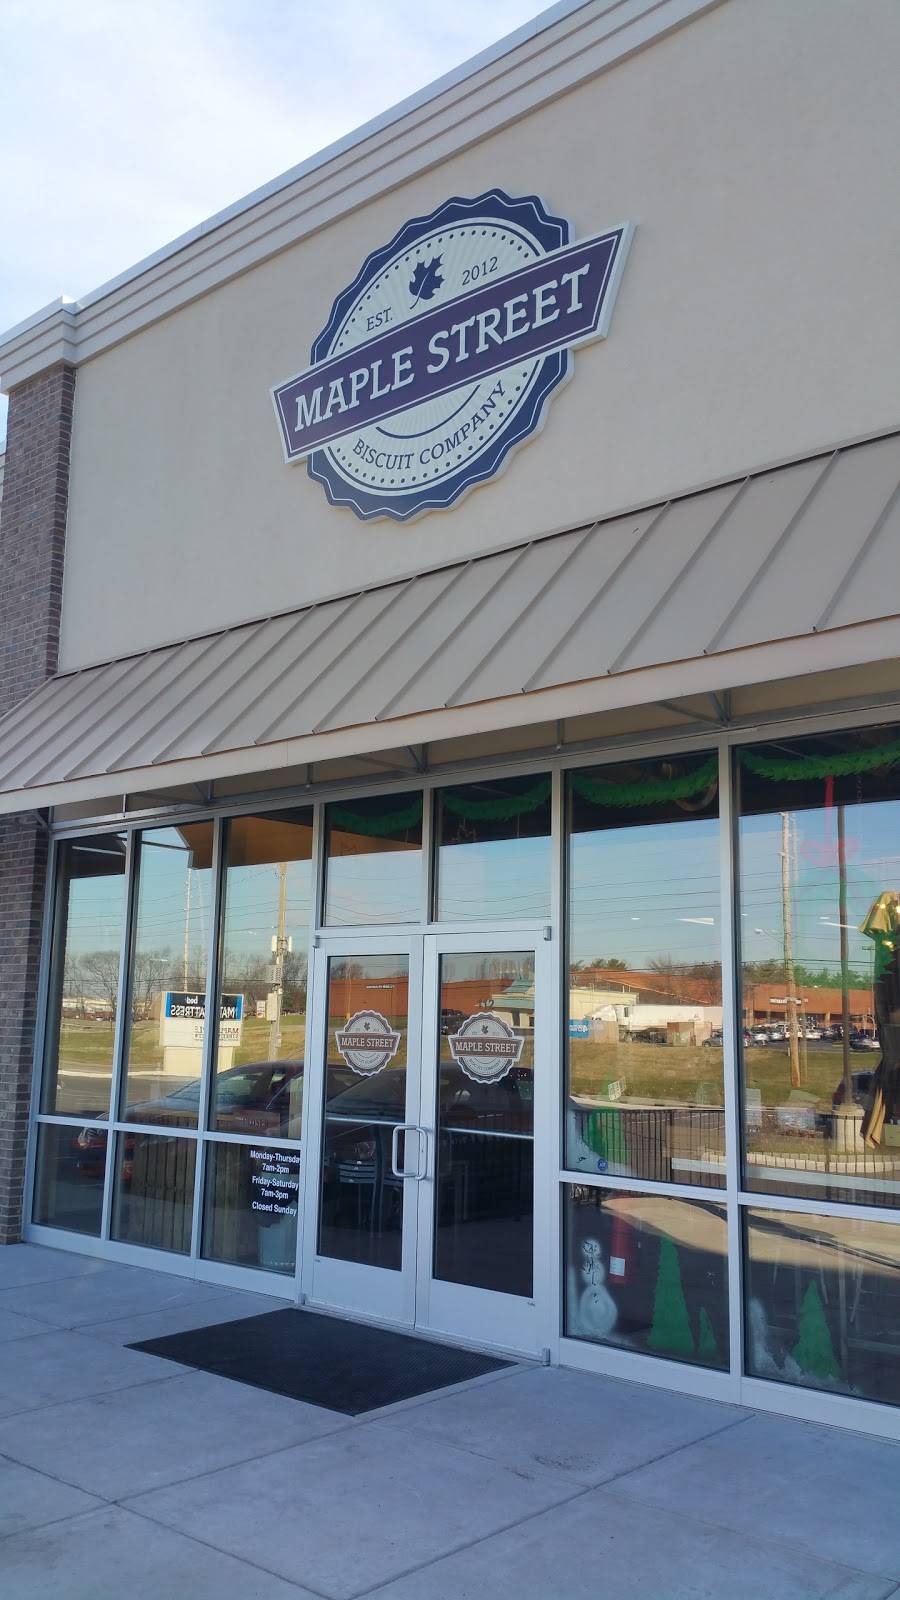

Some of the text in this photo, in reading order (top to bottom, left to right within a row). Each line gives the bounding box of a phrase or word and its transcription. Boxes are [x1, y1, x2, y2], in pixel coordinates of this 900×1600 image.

[366, 256, 499, 332] EST. 2012
[294, 263, 590, 432] MAPLE STREET
[352, 379, 506, 470] BISCUIT COMPANY
[341, 1037, 394, 1048] MAPLE STREET
[455, 1041, 517, 1053] MAPLE STREET
[250, 1150, 301, 1164] Monday-Thursda
[262, 1163, 290, 1175] 7am-2pm
[252, 1176, 299, 1191] Friday-Saturday
[261, 1188, 289, 1200] 7am-3pm
[252, 1201, 298, 1217] Closed Sunday
